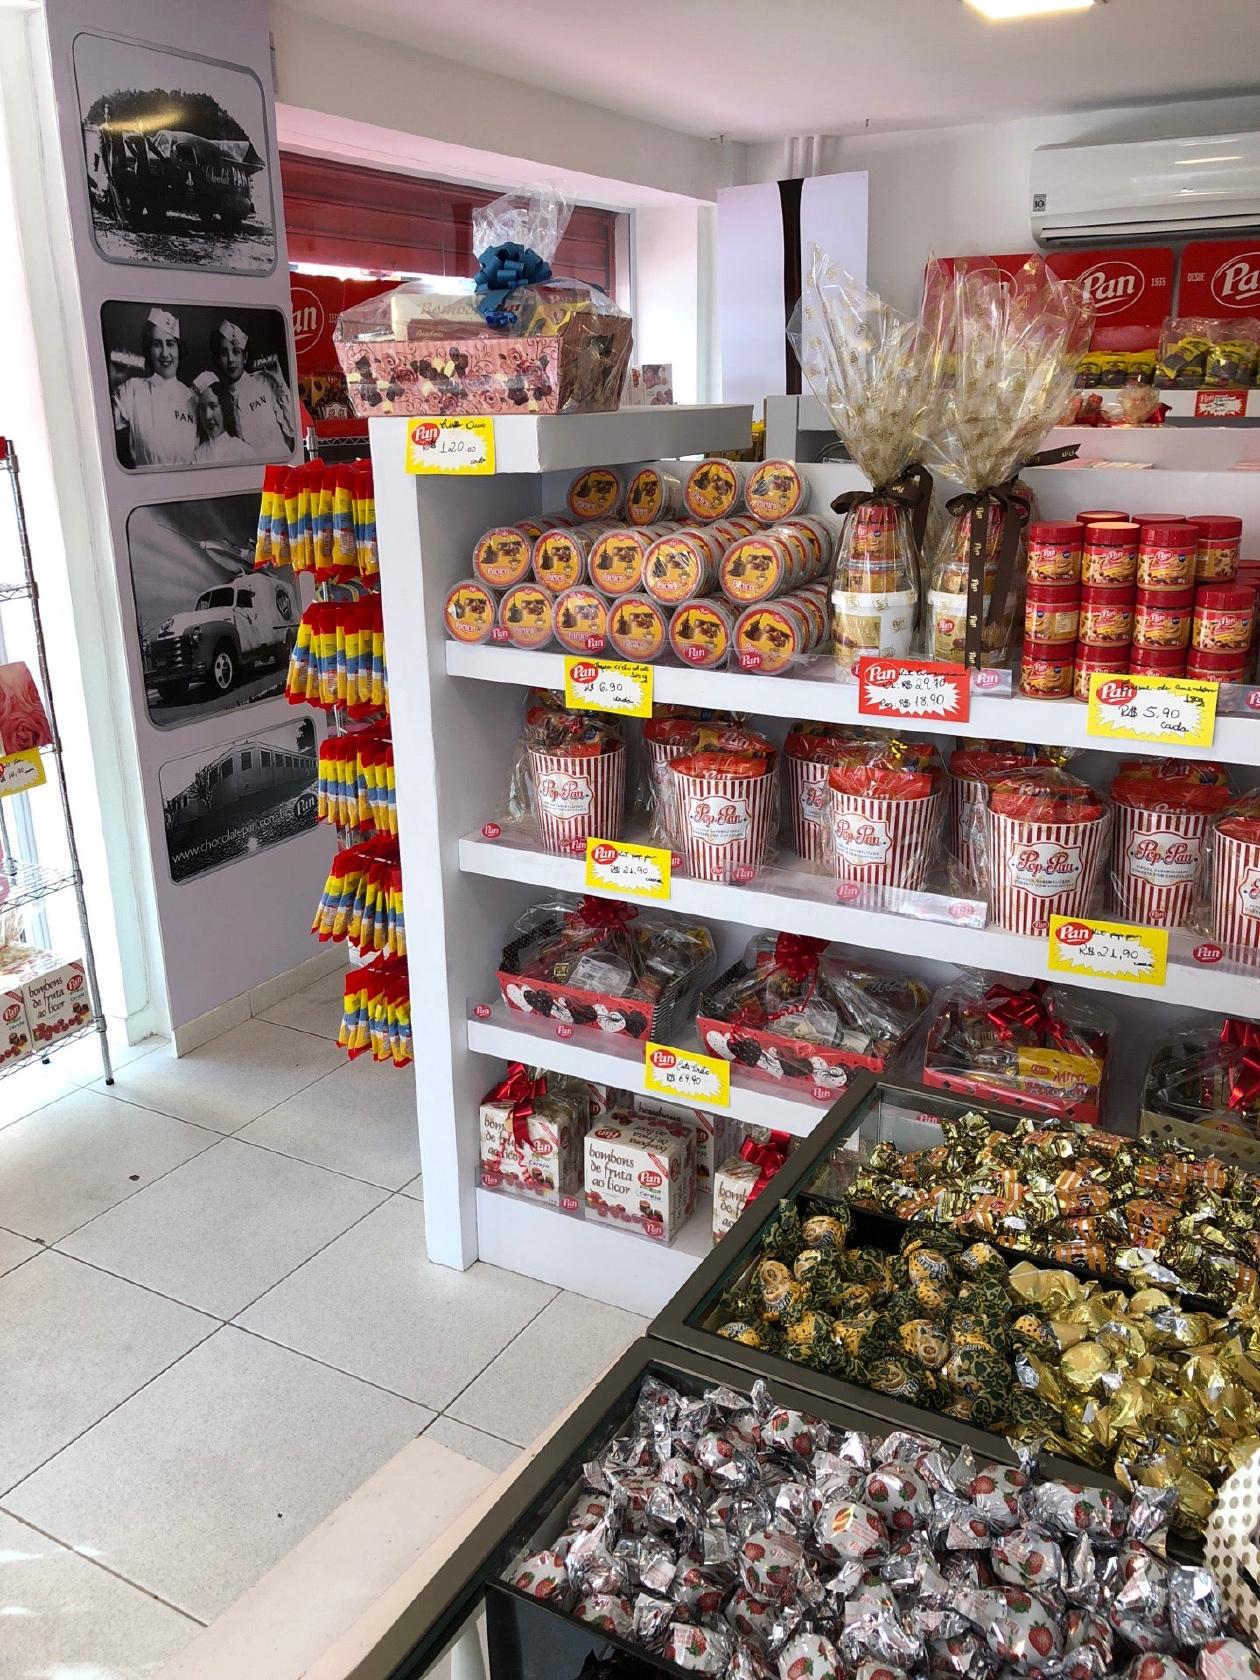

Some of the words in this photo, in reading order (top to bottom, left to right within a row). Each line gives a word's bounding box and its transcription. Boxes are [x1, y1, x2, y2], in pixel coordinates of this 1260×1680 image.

[1081, 271, 1135, 303] Pan
[1221, 262, 1260, 297] Pa
[291, 306, 317, 335] an
[250, 396, 267, 411] PAN
[174, 410, 194, 424] PAN
[415, 426, 438, 441] Pan
[1043, 549, 1056, 558] Pan
[1156, 551, 1172, 560] Pan
[938, 621, 953, 630] Pan
[493, 628, 509, 639] Pan
[587, 637, 604, 648] Pan
[688, 647, 705, 659] Pan
[742, 655, 761, 667] Pan
[573, 665, 596, 680] Pan
[870, 666, 896, 683] Pan
[977, 672, 998, 687] Pan
[1102, 682, 1133, 702] Pan
[1120, 705, 1138, 718] R$
[1143, 706, 1180, 719] 5,90
[1160, 721, 1190, 732] cada
[560, 780, 584, 800] Pan
[296, 796, 316, 818] Pan
[717, 804, 742, 825] Pan
[484, 826, 499, 835] Pan
[855, 824, 881, 846] Pan
[594, 846, 616, 861] Pan
[1164, 842, 1193, 864] Pan
[1043, 851, 1074, 875] Pan
[736, 869, 753, 879] Pan
[839, 886, 857, 897] Pan
[1060, 925, 1088, 942] Pan
[1079, 944, 1094, 956] R$
[1097, 946, 1138, 960] 21,90
[1197, 947, 1220, 960] Pan
[27, 976, 64, 998] bombons
[67, 975, 83, 991] Pan
[32, 998, 44, 1009] de
[43, 989, 65, 1009] fruta
[4, 1005, 20, 1021] Pan
[37, 1009, 46, 1019] ao
[47, 1000, 66, 1015] licor
[476, 1007, 491, 1017] Pan
[557, 1026, 572, 1037] Pan
[653, 1051, 674, 1066] Pan
[679, 1074, 702, 1085] 69,90
[813, 1088, 831, 1099] Pan
[485, 1130, 496, 1142] de
[597, 1130, 621, 1139] Pan
[629, 1138, 668, 1153] bombons
[589, 1143, 635, 1168] bombons
[590, 1160, 602, 1172] de
[604, 1163, 633, 1181] fruta
[485, 1175, 498, 1185] Pan
[592, 1177, 605, 1188] ao
[607, 1176, 631, 1195] licor
[640, 1171, 661, 1186] Pan
[563, 1198, 578, 1209] Pan
[720, 1199, 732, 1211] de
[647, 1225, 662, 1235] Pan
